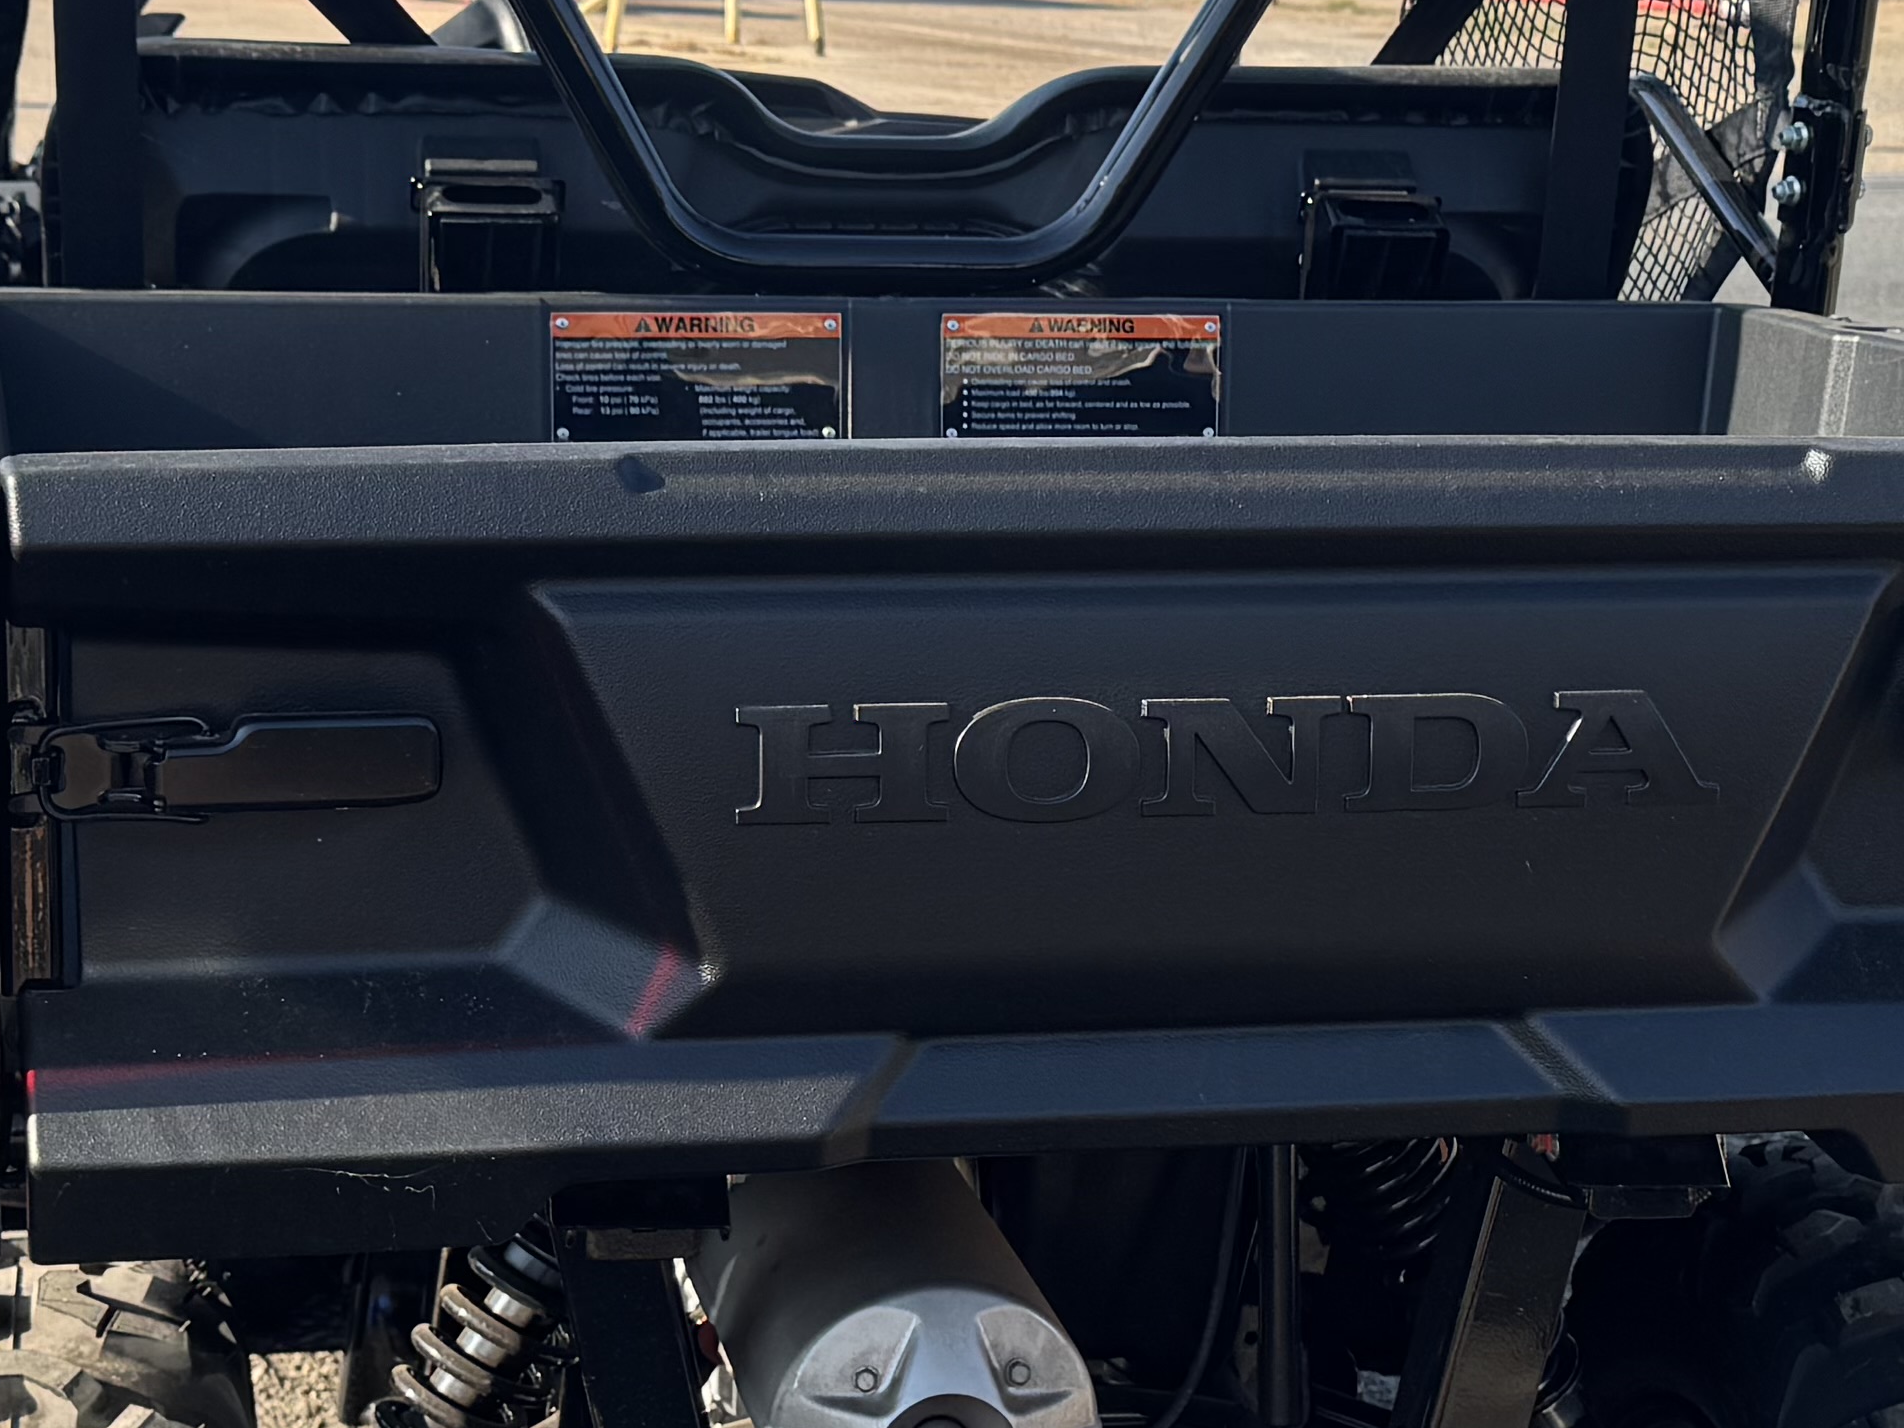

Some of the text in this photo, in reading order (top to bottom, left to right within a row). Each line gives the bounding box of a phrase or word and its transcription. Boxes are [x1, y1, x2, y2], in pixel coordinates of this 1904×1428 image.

[654, 316, 755, 333] WARNING
[1047, 317, 1135, 333] WARNING
[1019, 353, 1054, 361] CARGO
[555, 362, 574, 370] Loss
[961, 365, 982, 374] NOT
[983, 365, 1035, 374] OVERLOAD
[1036, 365, 1071, 374] CARGO
[556, 373, 580, 381] Check
[626, 373, 645, 381] each
[565, 384, 584, 393] Cold
[734, 689, 1720, 824] HONDA
